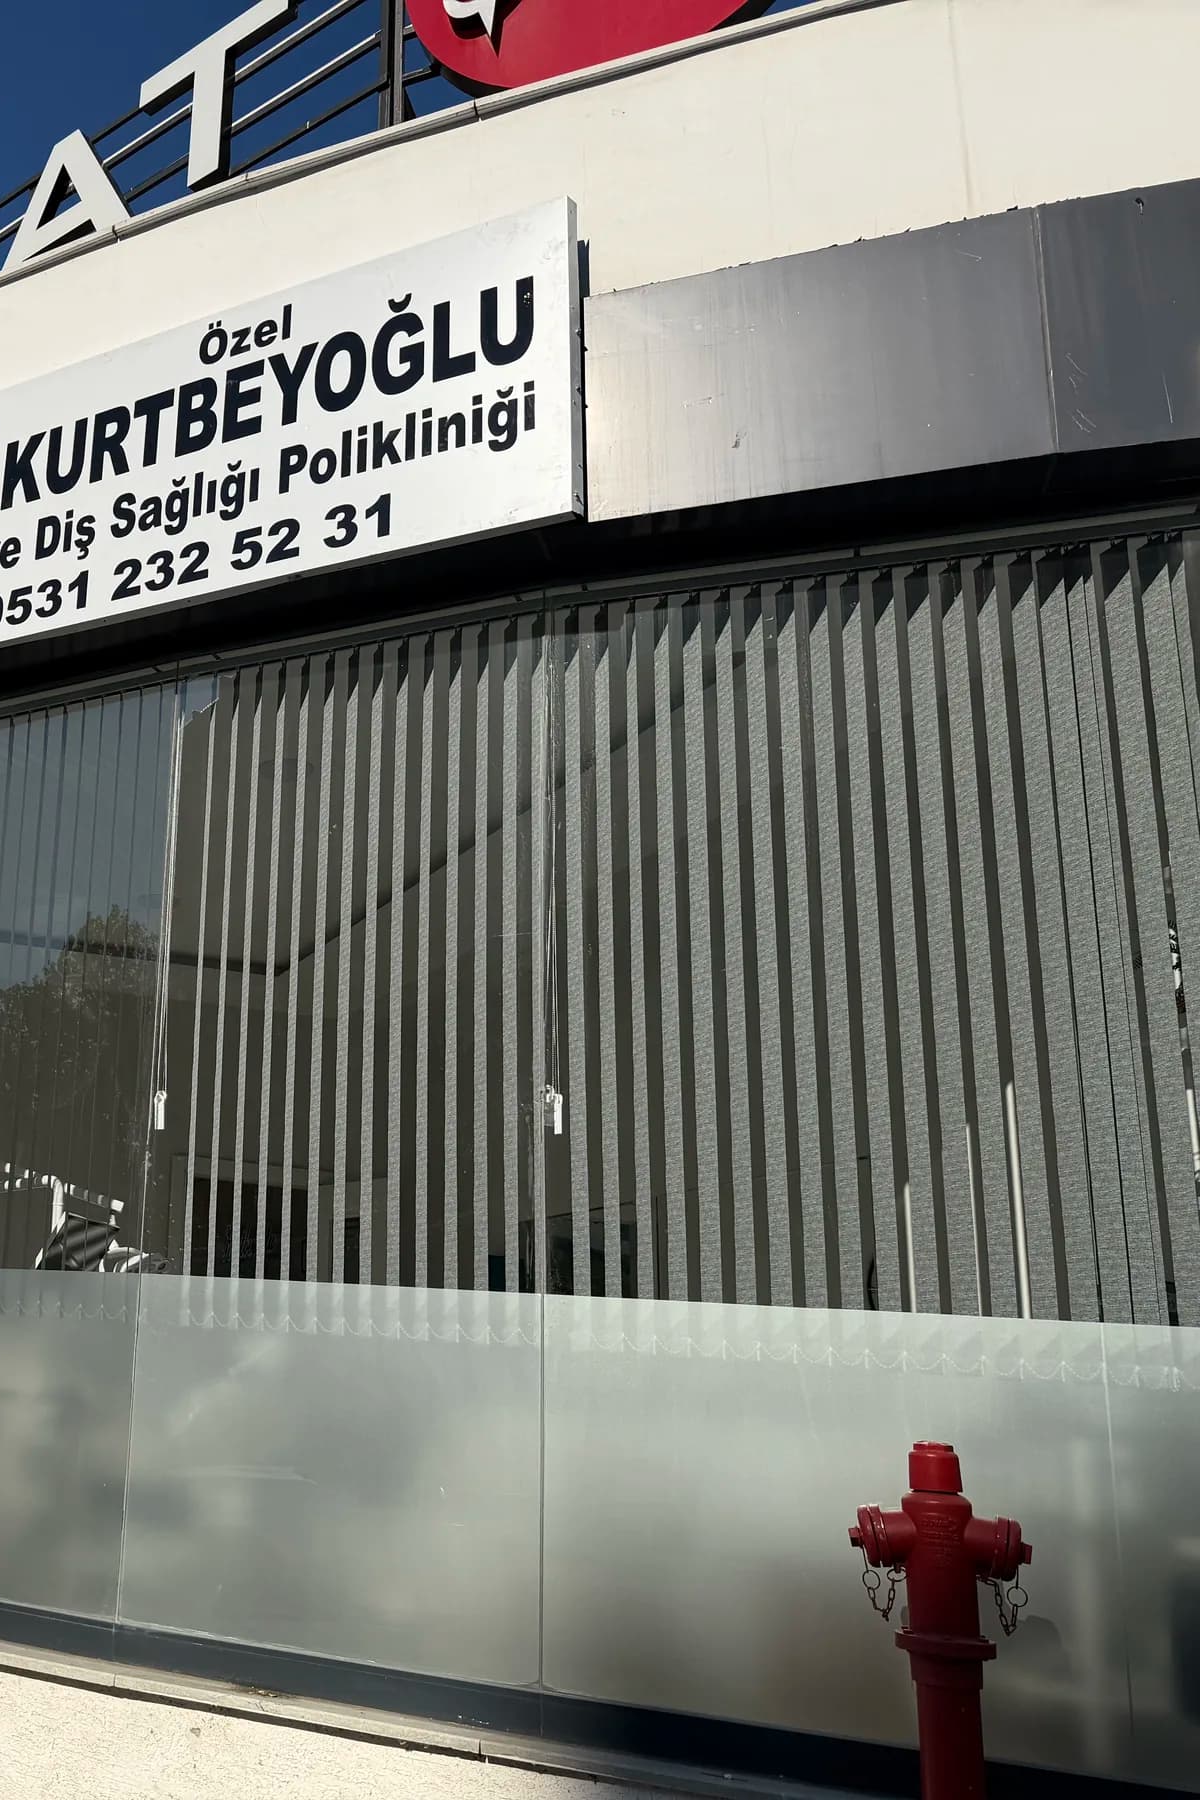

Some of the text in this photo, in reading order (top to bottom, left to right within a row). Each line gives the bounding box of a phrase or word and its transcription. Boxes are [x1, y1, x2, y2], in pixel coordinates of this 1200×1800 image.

[0, 275, 535, 511] KURTBEYOĞLU
[198, 303, 293, 366] Özel
[34, 509, 96, 561] Diş
[110, 459, 260, 539] Sağlığı
[278, 380, 536, 495] Polikliniği
[110, 541, 210, 602] 232
[230, 518, 301, 571] 52
[323, 493, 391, 549] 31
